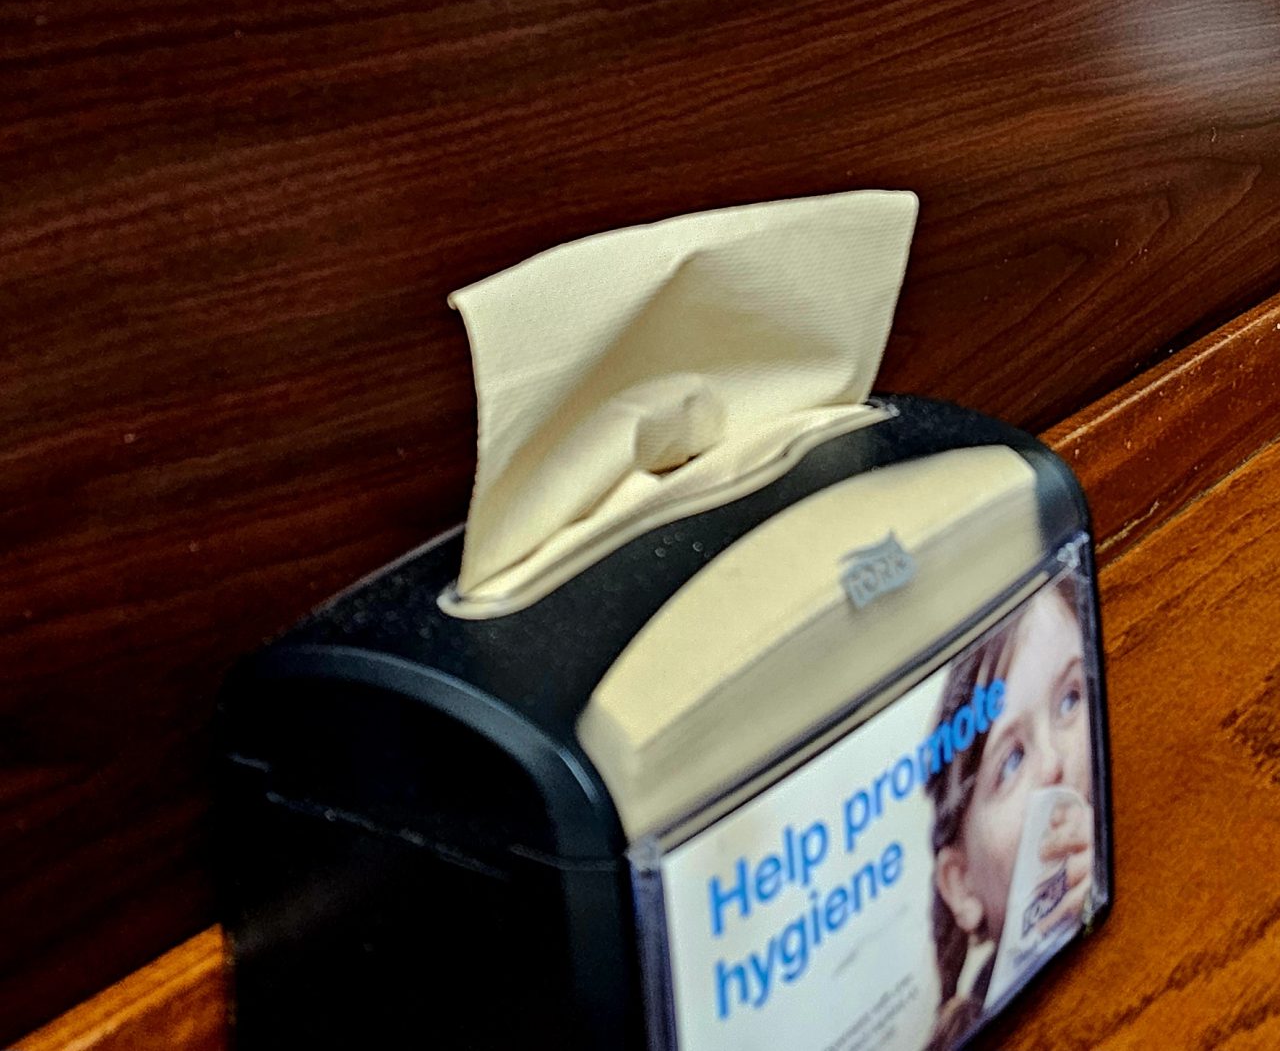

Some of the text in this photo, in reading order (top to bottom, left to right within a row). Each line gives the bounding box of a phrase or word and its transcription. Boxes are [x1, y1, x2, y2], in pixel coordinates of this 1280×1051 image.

[708, 678, 1007, 937] Help promote
[714, 841, 905, 1020] hygiene
